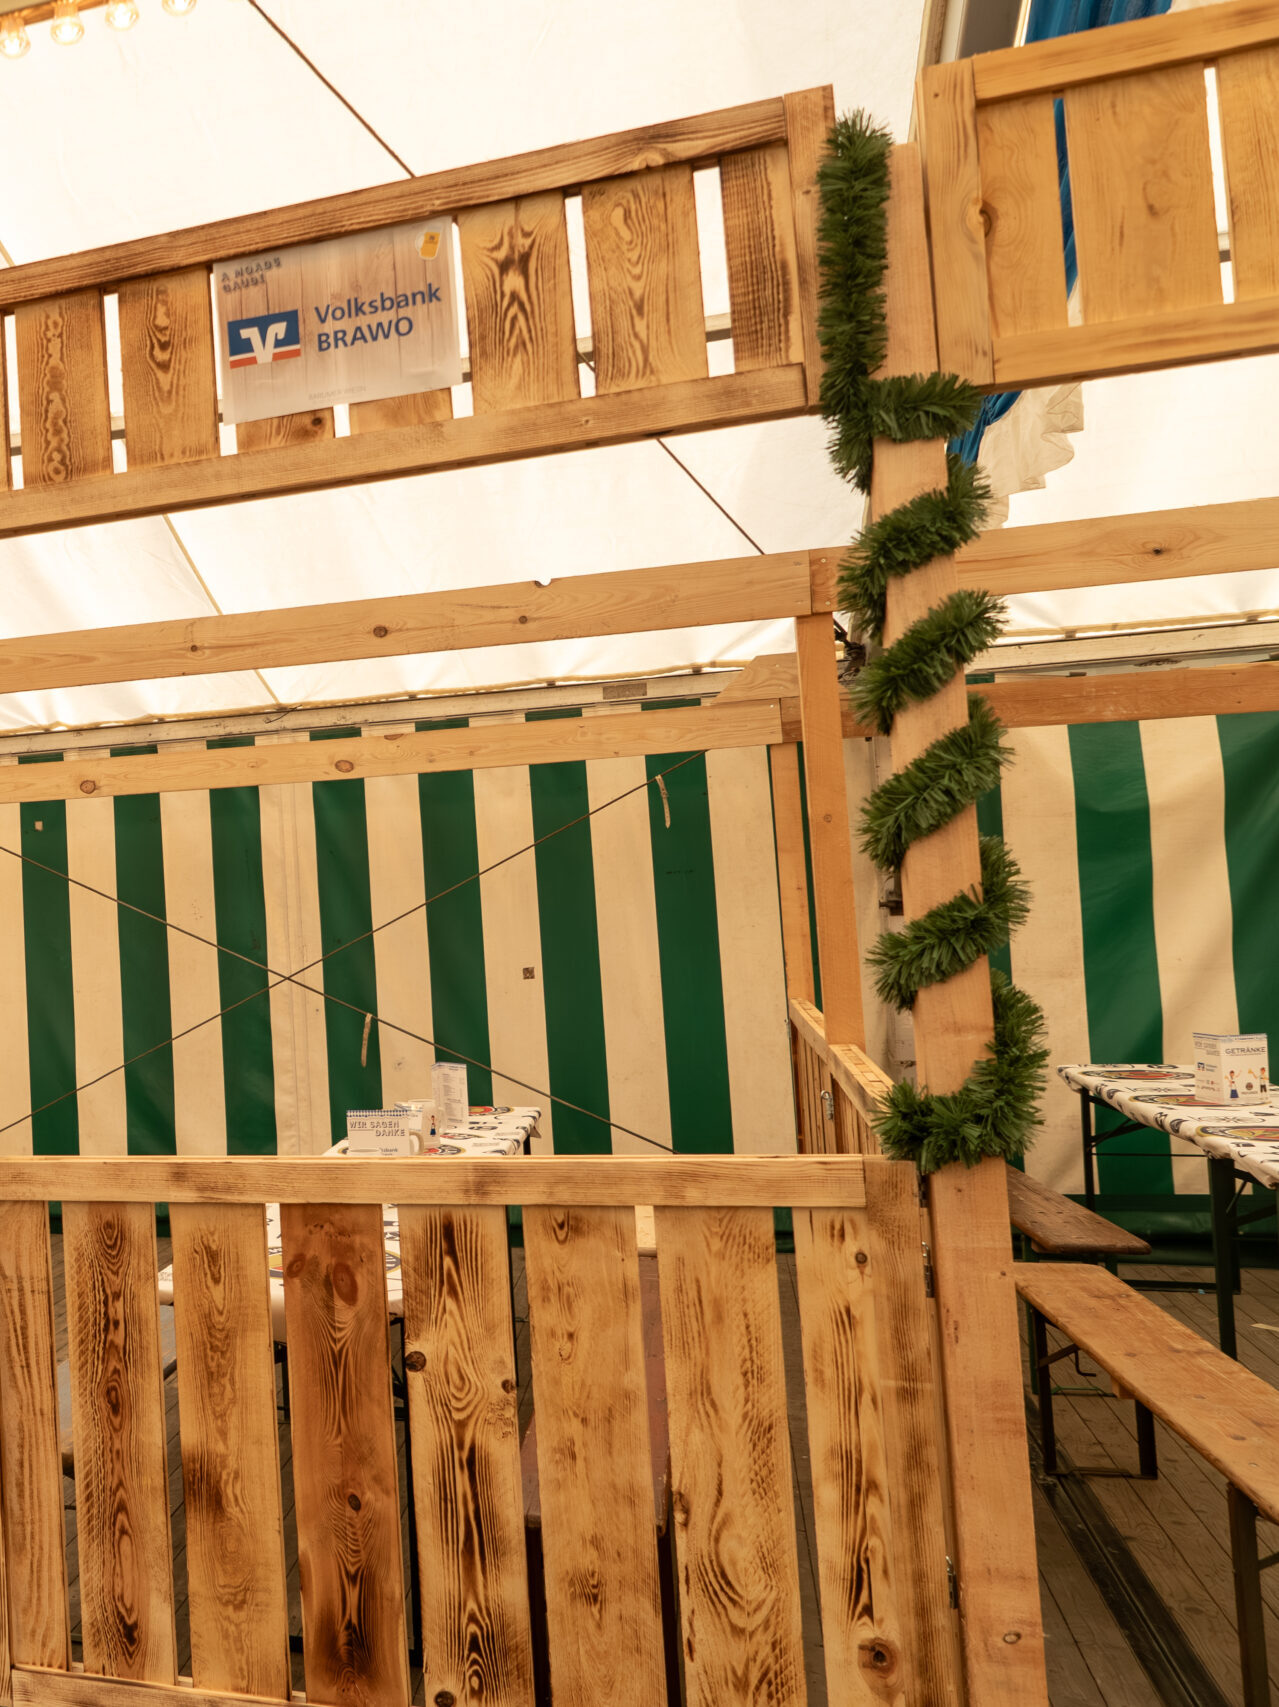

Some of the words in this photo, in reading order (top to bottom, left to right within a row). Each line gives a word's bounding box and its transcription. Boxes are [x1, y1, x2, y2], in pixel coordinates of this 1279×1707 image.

[314, 283, 442, 324] Volksbank
[317, 316, 414, 353] BRAWO
[350, 1121, 367, 1129] WIR
[370, 1120, 400, 1129] SAGEN
[375, 1129, 405, 1137] DANKE
